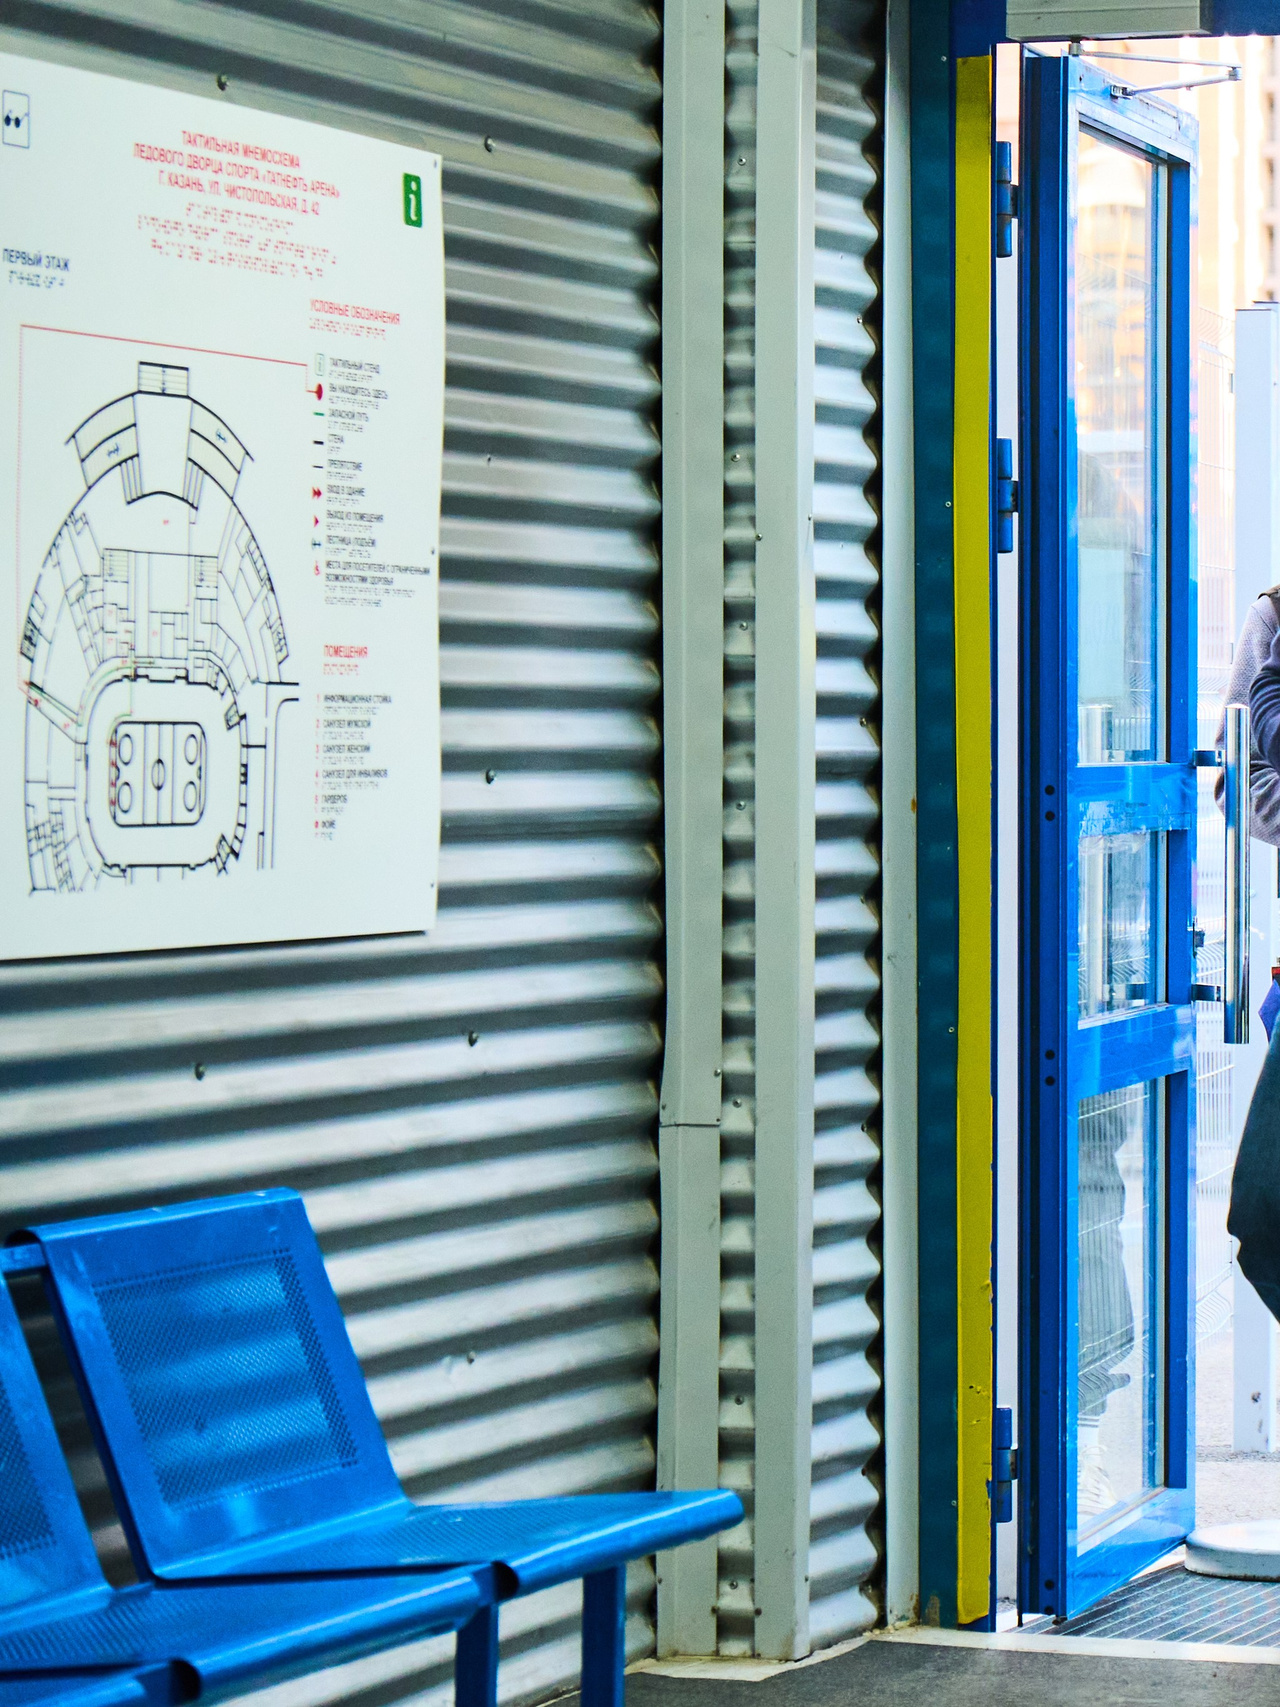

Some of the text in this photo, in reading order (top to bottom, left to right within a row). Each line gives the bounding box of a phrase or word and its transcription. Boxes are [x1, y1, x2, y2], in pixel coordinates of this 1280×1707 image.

[182, 130, 300, 169] ТАКТИЛЬНАЯ МНЕМОСХЕМА
[133, 142, 340, 199] ЛЕДОВОГО ДВОРЦА СПОРТА «ТАТНЕФТЬ АРЕНА»
[167, 171, 206, 194] КАЗАНЬ,
[207, 179, 222, 196] УЛ.
[222, 183, 299, 212] ЧИСТОПОЛЬСКАЯ,
[300, 198, 309, 215] Д.
[310, 201, 320, 216] 42
[3, 248, 70, 271] ПЕРВЫЙ ЭТАЖ
[310, 299, 400, 325] УСЛОВНЫЕ ОБОЗНАЧЕНИЯ
[323, 644, 369, 659] ПОМЕЩЕНИЯ
